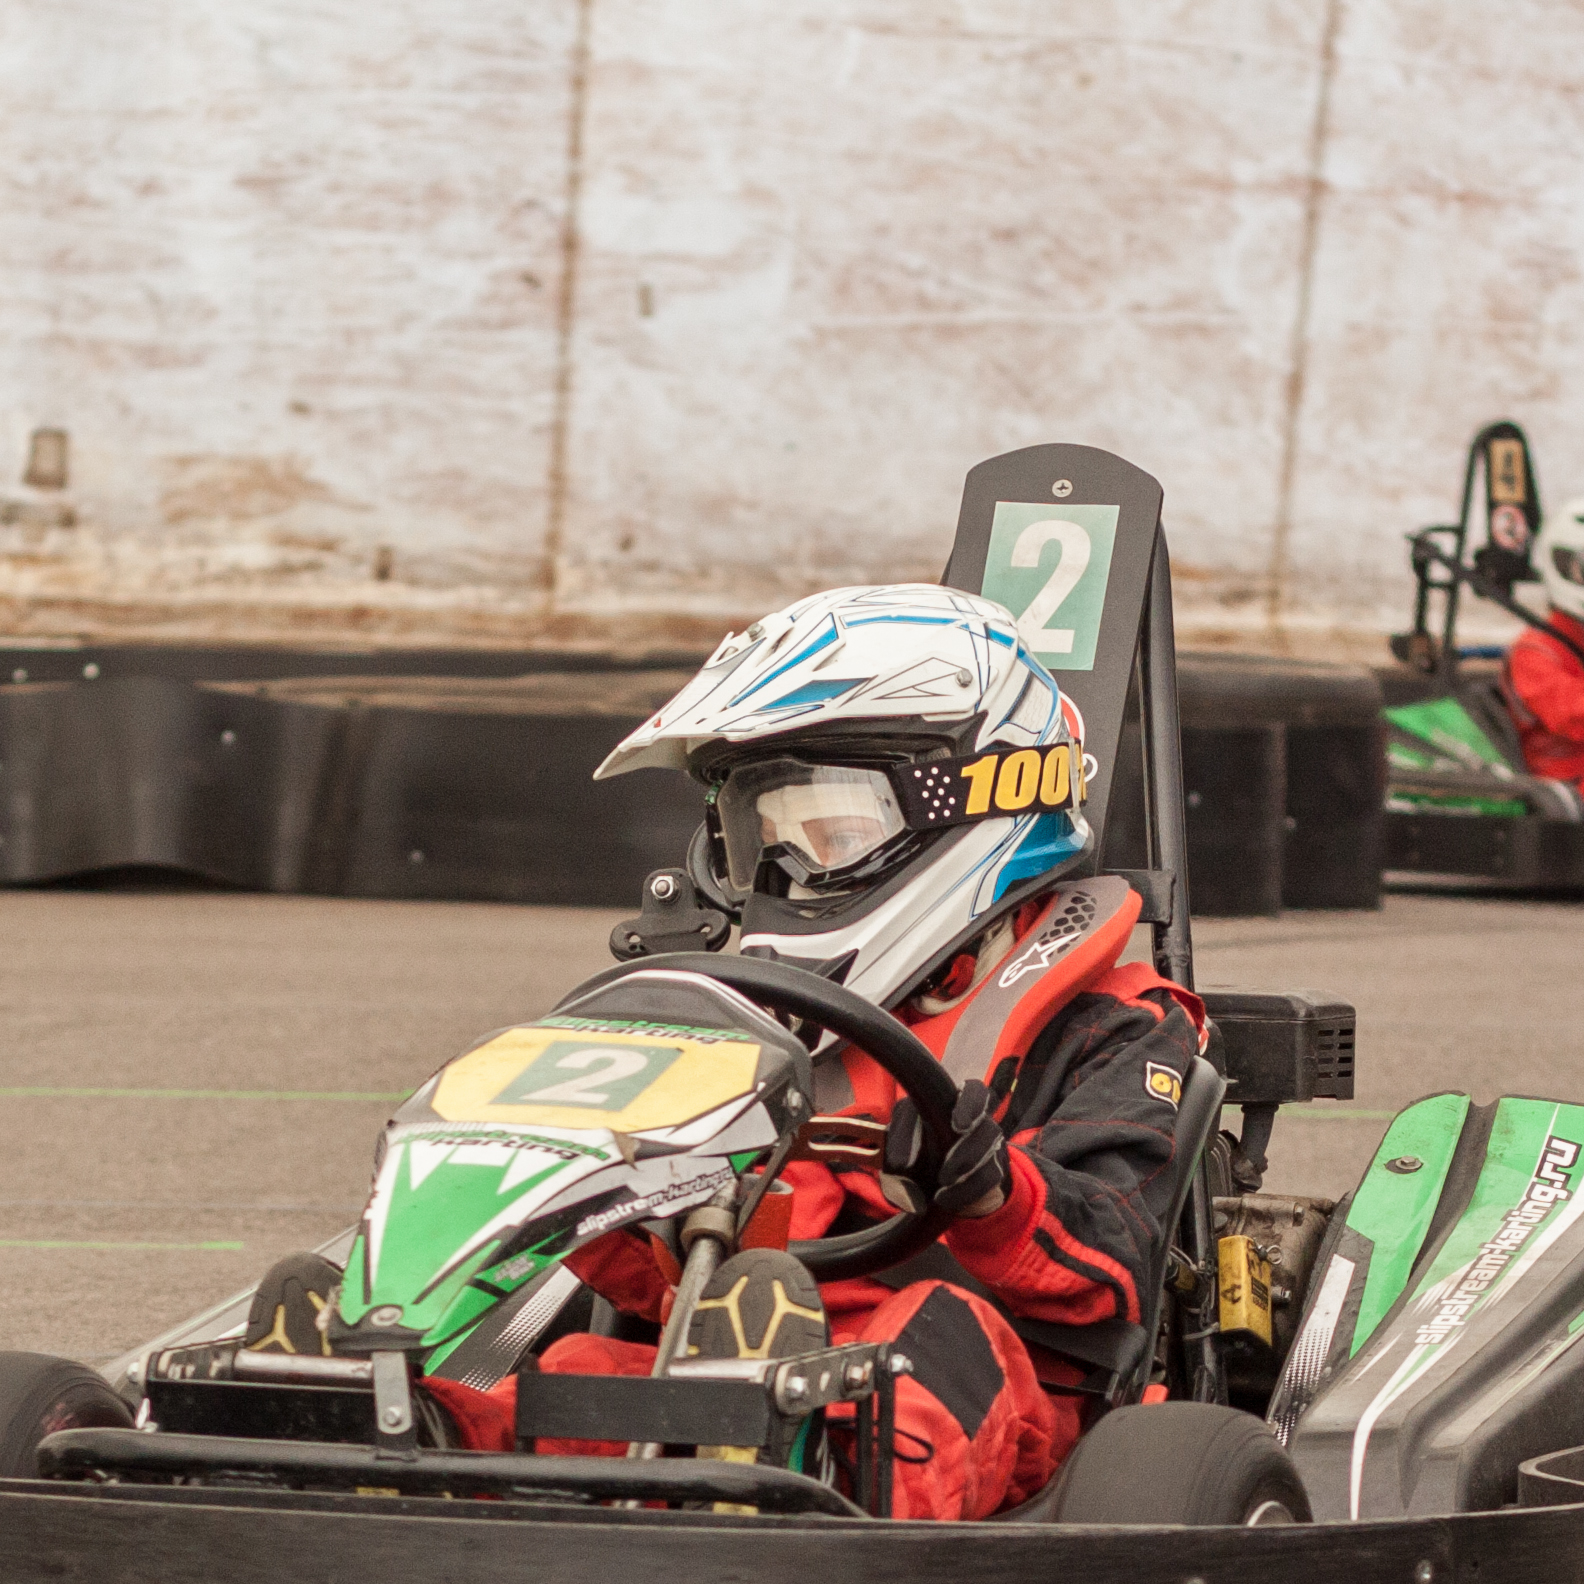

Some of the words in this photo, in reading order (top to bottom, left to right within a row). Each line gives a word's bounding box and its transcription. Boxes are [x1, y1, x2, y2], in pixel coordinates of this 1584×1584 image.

[1010, 519, 1092, 654] 2
[518, 1048, 649, 1105] 2
[429, 1138, 579, 1160] karting
[1413, 1136, 1581, 1346] slipstream-karting.ru
